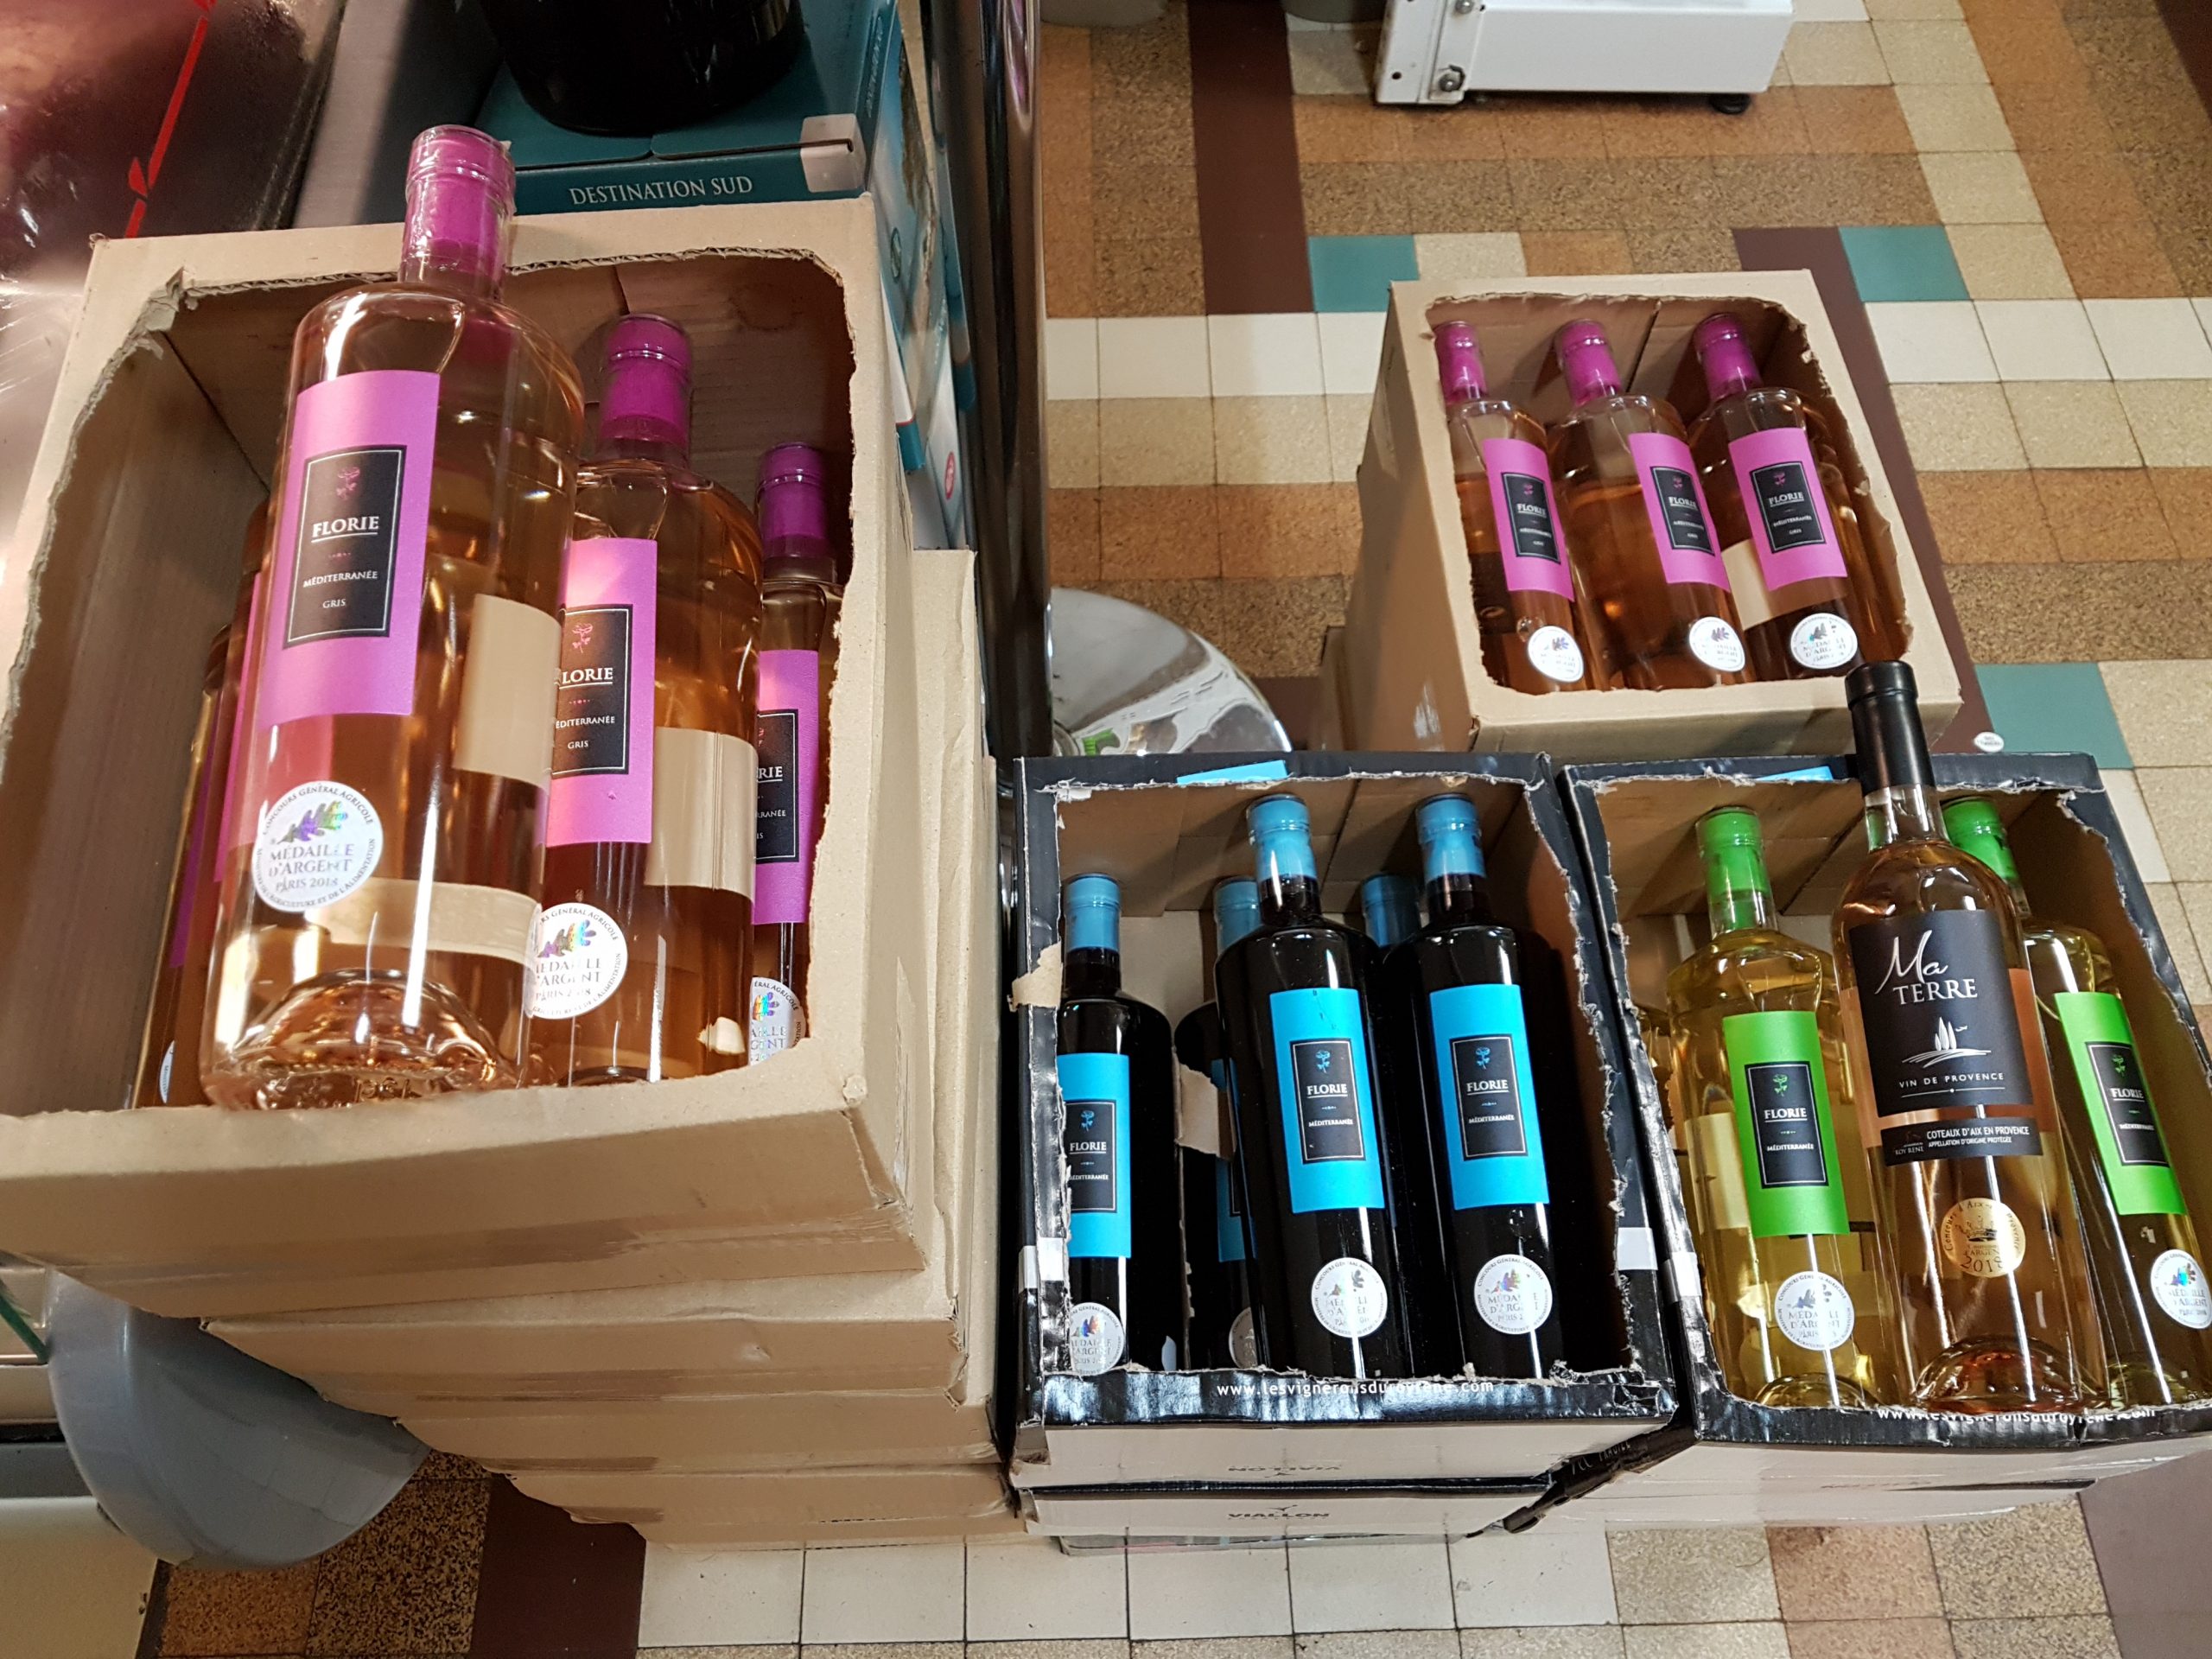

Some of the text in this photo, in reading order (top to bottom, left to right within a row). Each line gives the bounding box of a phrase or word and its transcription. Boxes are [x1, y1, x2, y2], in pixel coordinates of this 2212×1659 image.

[569, 175, 753, 206] DESTINATION SUD
[1768, 492, 1805, 505] FLORIE
[311, 516, 379, 538] FLORIE
[302, 570, 378, 588] MÉDITERRANÉE
[322, 598, 346, 609] GRIS
[562, 668, 613, 684] LORIE
[555, 715, 616, 729] ÉDITERRANÉE
[567, 740, 589, 750] GRIS
[1875, 930, 1948, 995] Ma
[1892, 978, 1979, 1005] TERRE
[1466, 1079, 1509, 1093] FLORIE
[1899, 1072, 2005, 1089] VIN DE PROVENCE
[1306, 1084, 1348, 1096] FLORIE
[2110, 1088, 2145, 1099] FLORIE
[1764, 1107, 1808, 1120] FLORIE
[1308, 1118, 1353, 1127] MÉDITERRANÉE
[1927, 1125, 2031, 1140] COTEAUX D'AIX EN PROVENCE
[1070, 1141, 1107, 1152] FLORIE
[1766, 1142, 1815, 1152] MÉDITERRANÉE
